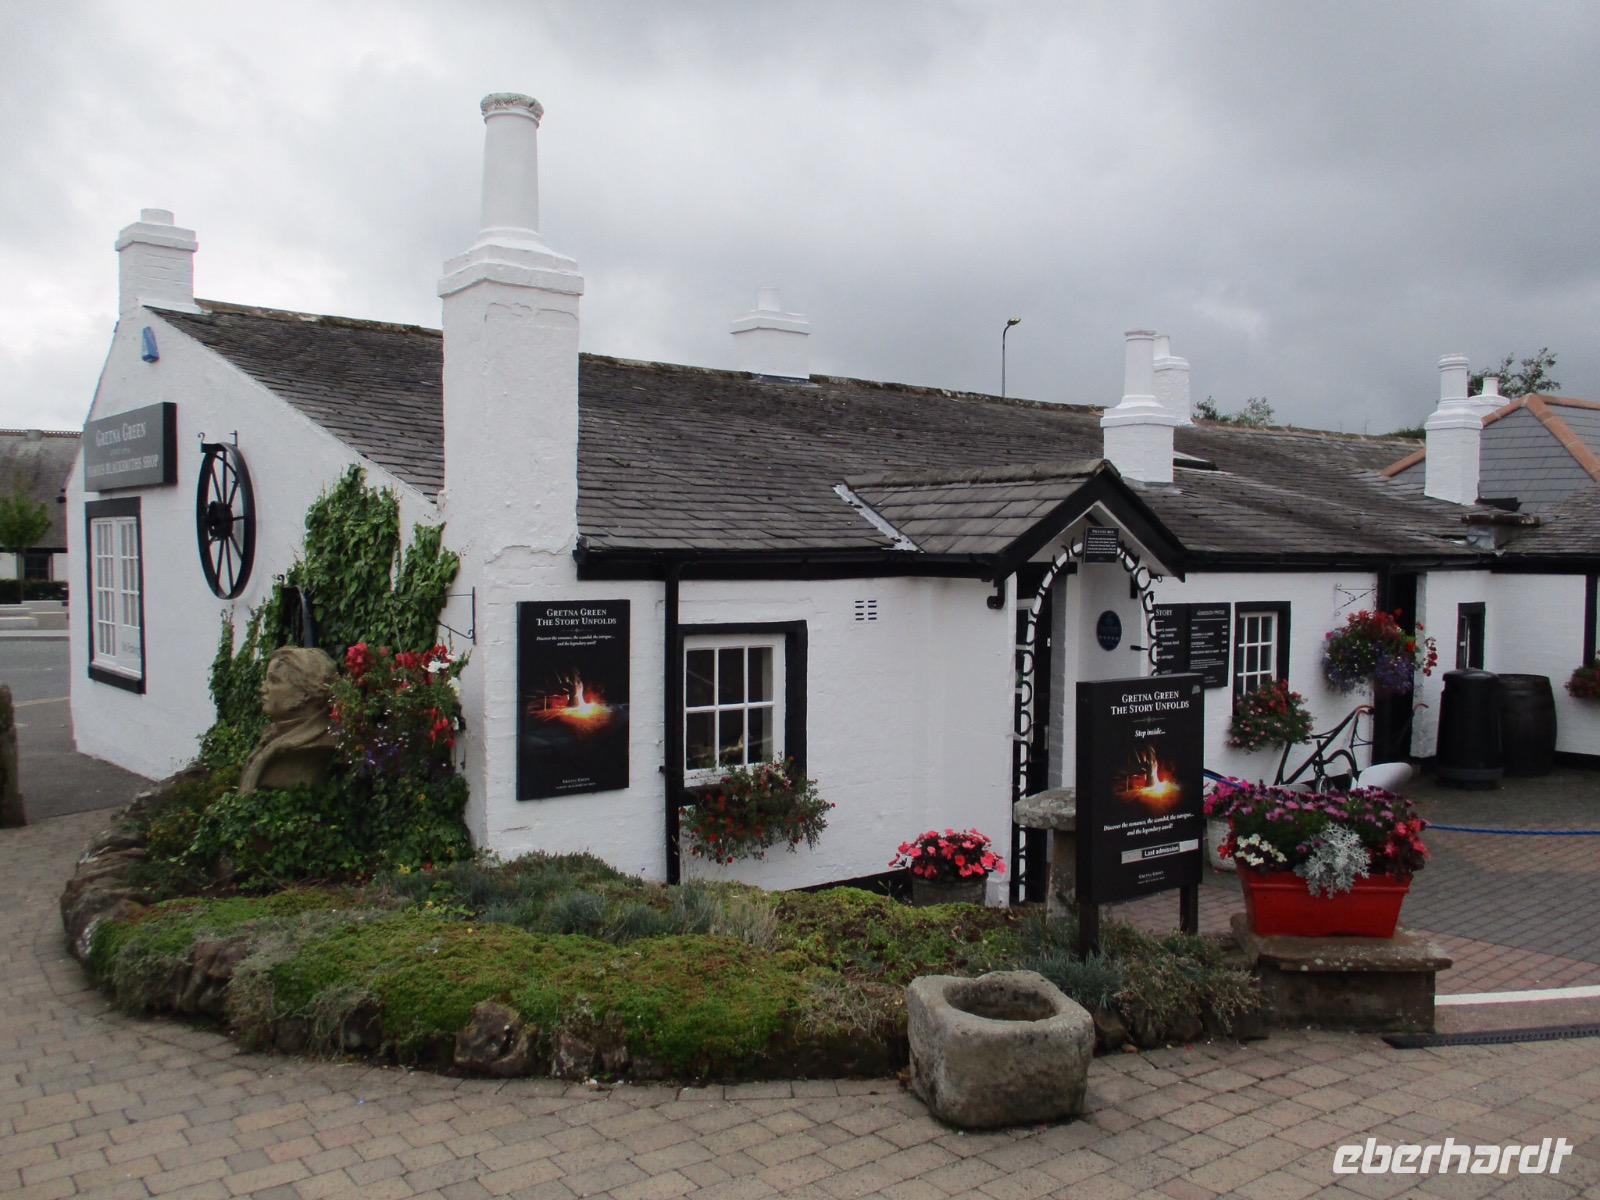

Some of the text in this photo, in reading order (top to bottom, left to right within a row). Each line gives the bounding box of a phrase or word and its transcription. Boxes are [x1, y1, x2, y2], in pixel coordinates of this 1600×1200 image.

[546, 607, 607, 617] GRETNA GREEN
[1156, 609, 1173, 617] STORY
[536, 617, 617, 626] THE STORY UNFOLDS
[1121, 690, 1179, 704] GRETNA GREEN
[1110, 700, 1190, 716] THE STORY UNFOLDS
[1134, 729, 1147, 738] Step
[1144, 845, 1179, 857] Last admission
